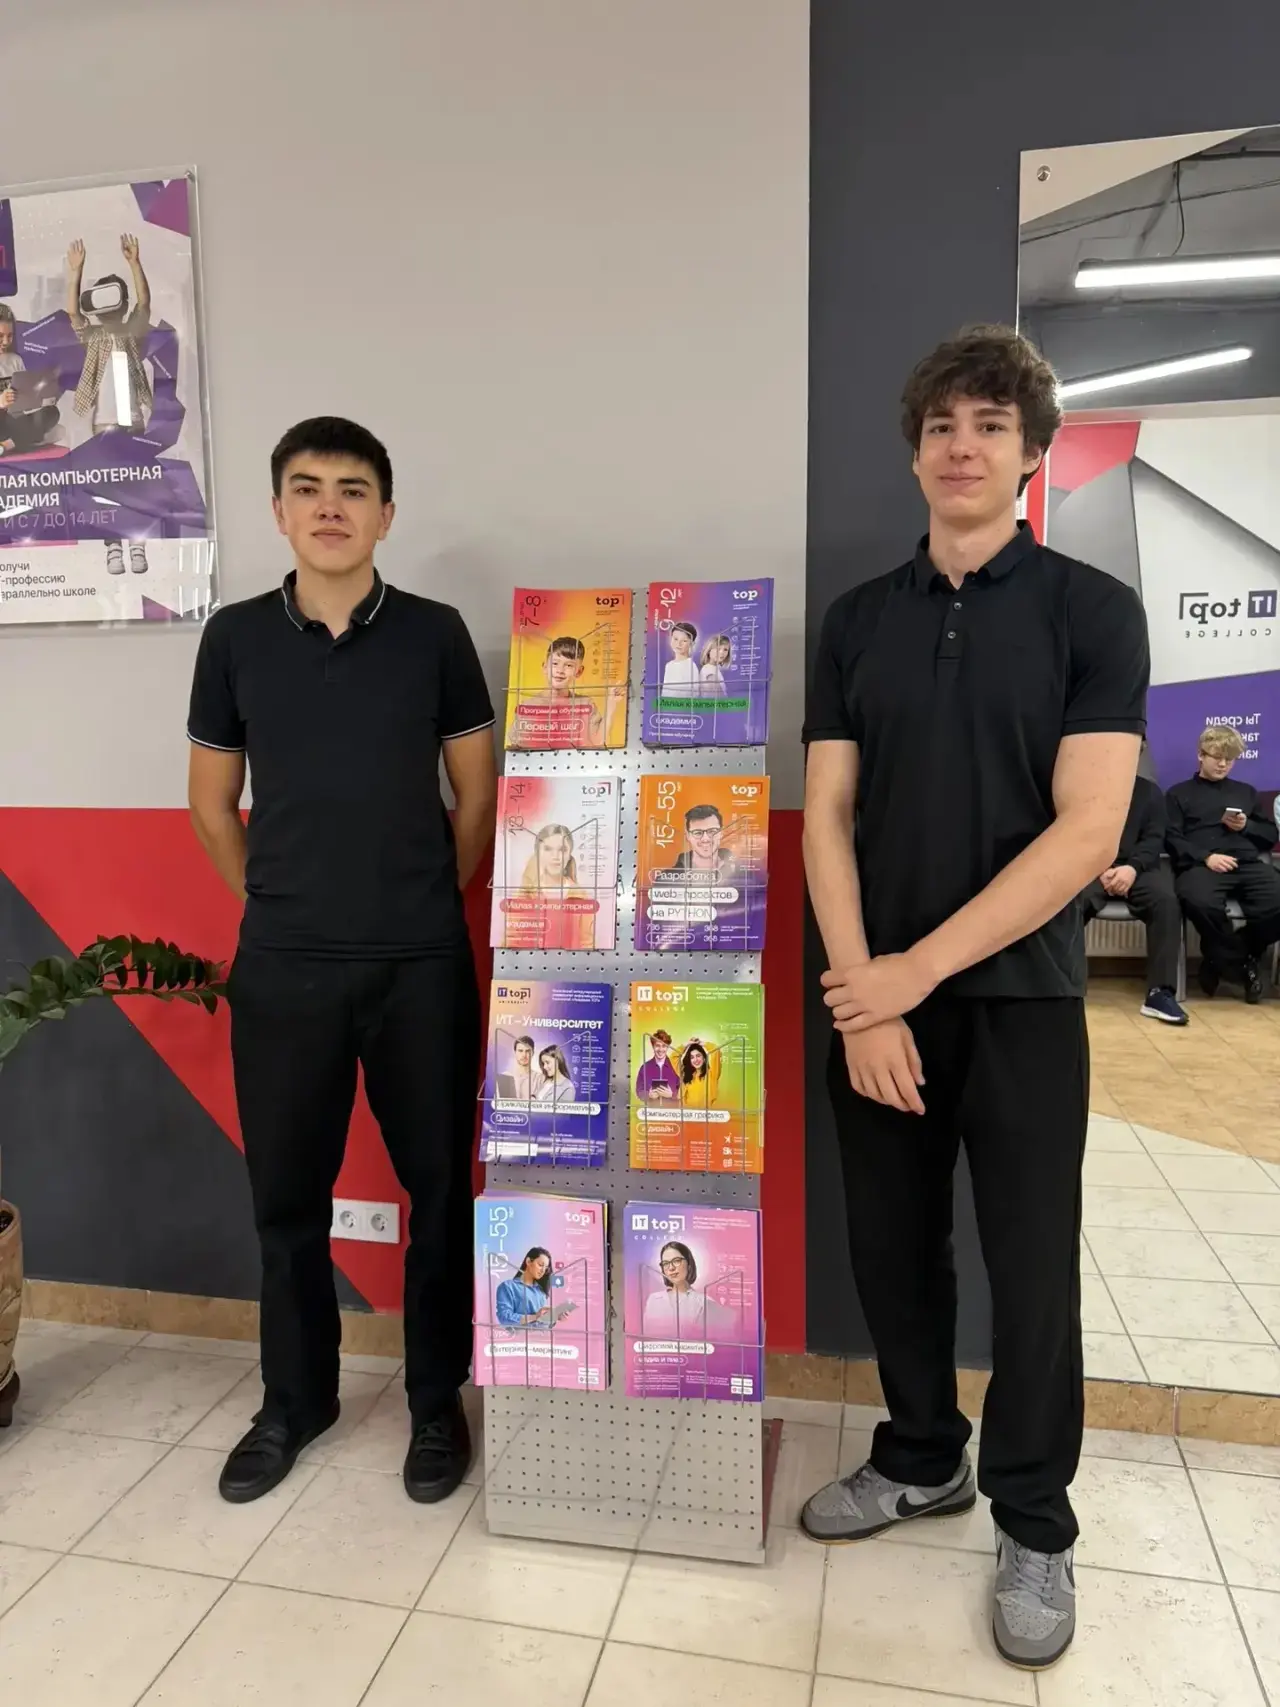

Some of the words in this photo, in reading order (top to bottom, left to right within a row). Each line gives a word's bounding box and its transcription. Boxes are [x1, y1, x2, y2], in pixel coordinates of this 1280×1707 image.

[30, 465, 162, 487] КОМПЬЮТЕРНАЯ
[18, 514, 29, 528] С
[30, 513, 40, 528] 7
[43, 512, 66, 529] ДО
[69, 511, 86, 526] 14
[89, 509, 118, 526] ЛЕТ
[0, 574, 66, 587] -профессию
[63, 587, 97, 597] школе
[732, 589, 758, 601] top
[595, 596, 620, 607] top
[582, 785, 606, 798] top
[731, 784, 758, 797] top
[654, 870, 716, 882] Разработка
[509, 990, 528, 1000] top
[639, 989, 651, 999] IT
[655, 990, 684, 1004] top
[564, 1211, 591, 1226] top
[634, 1218, 646, 1228] IT
[651, 1218, 680, 1233] top
